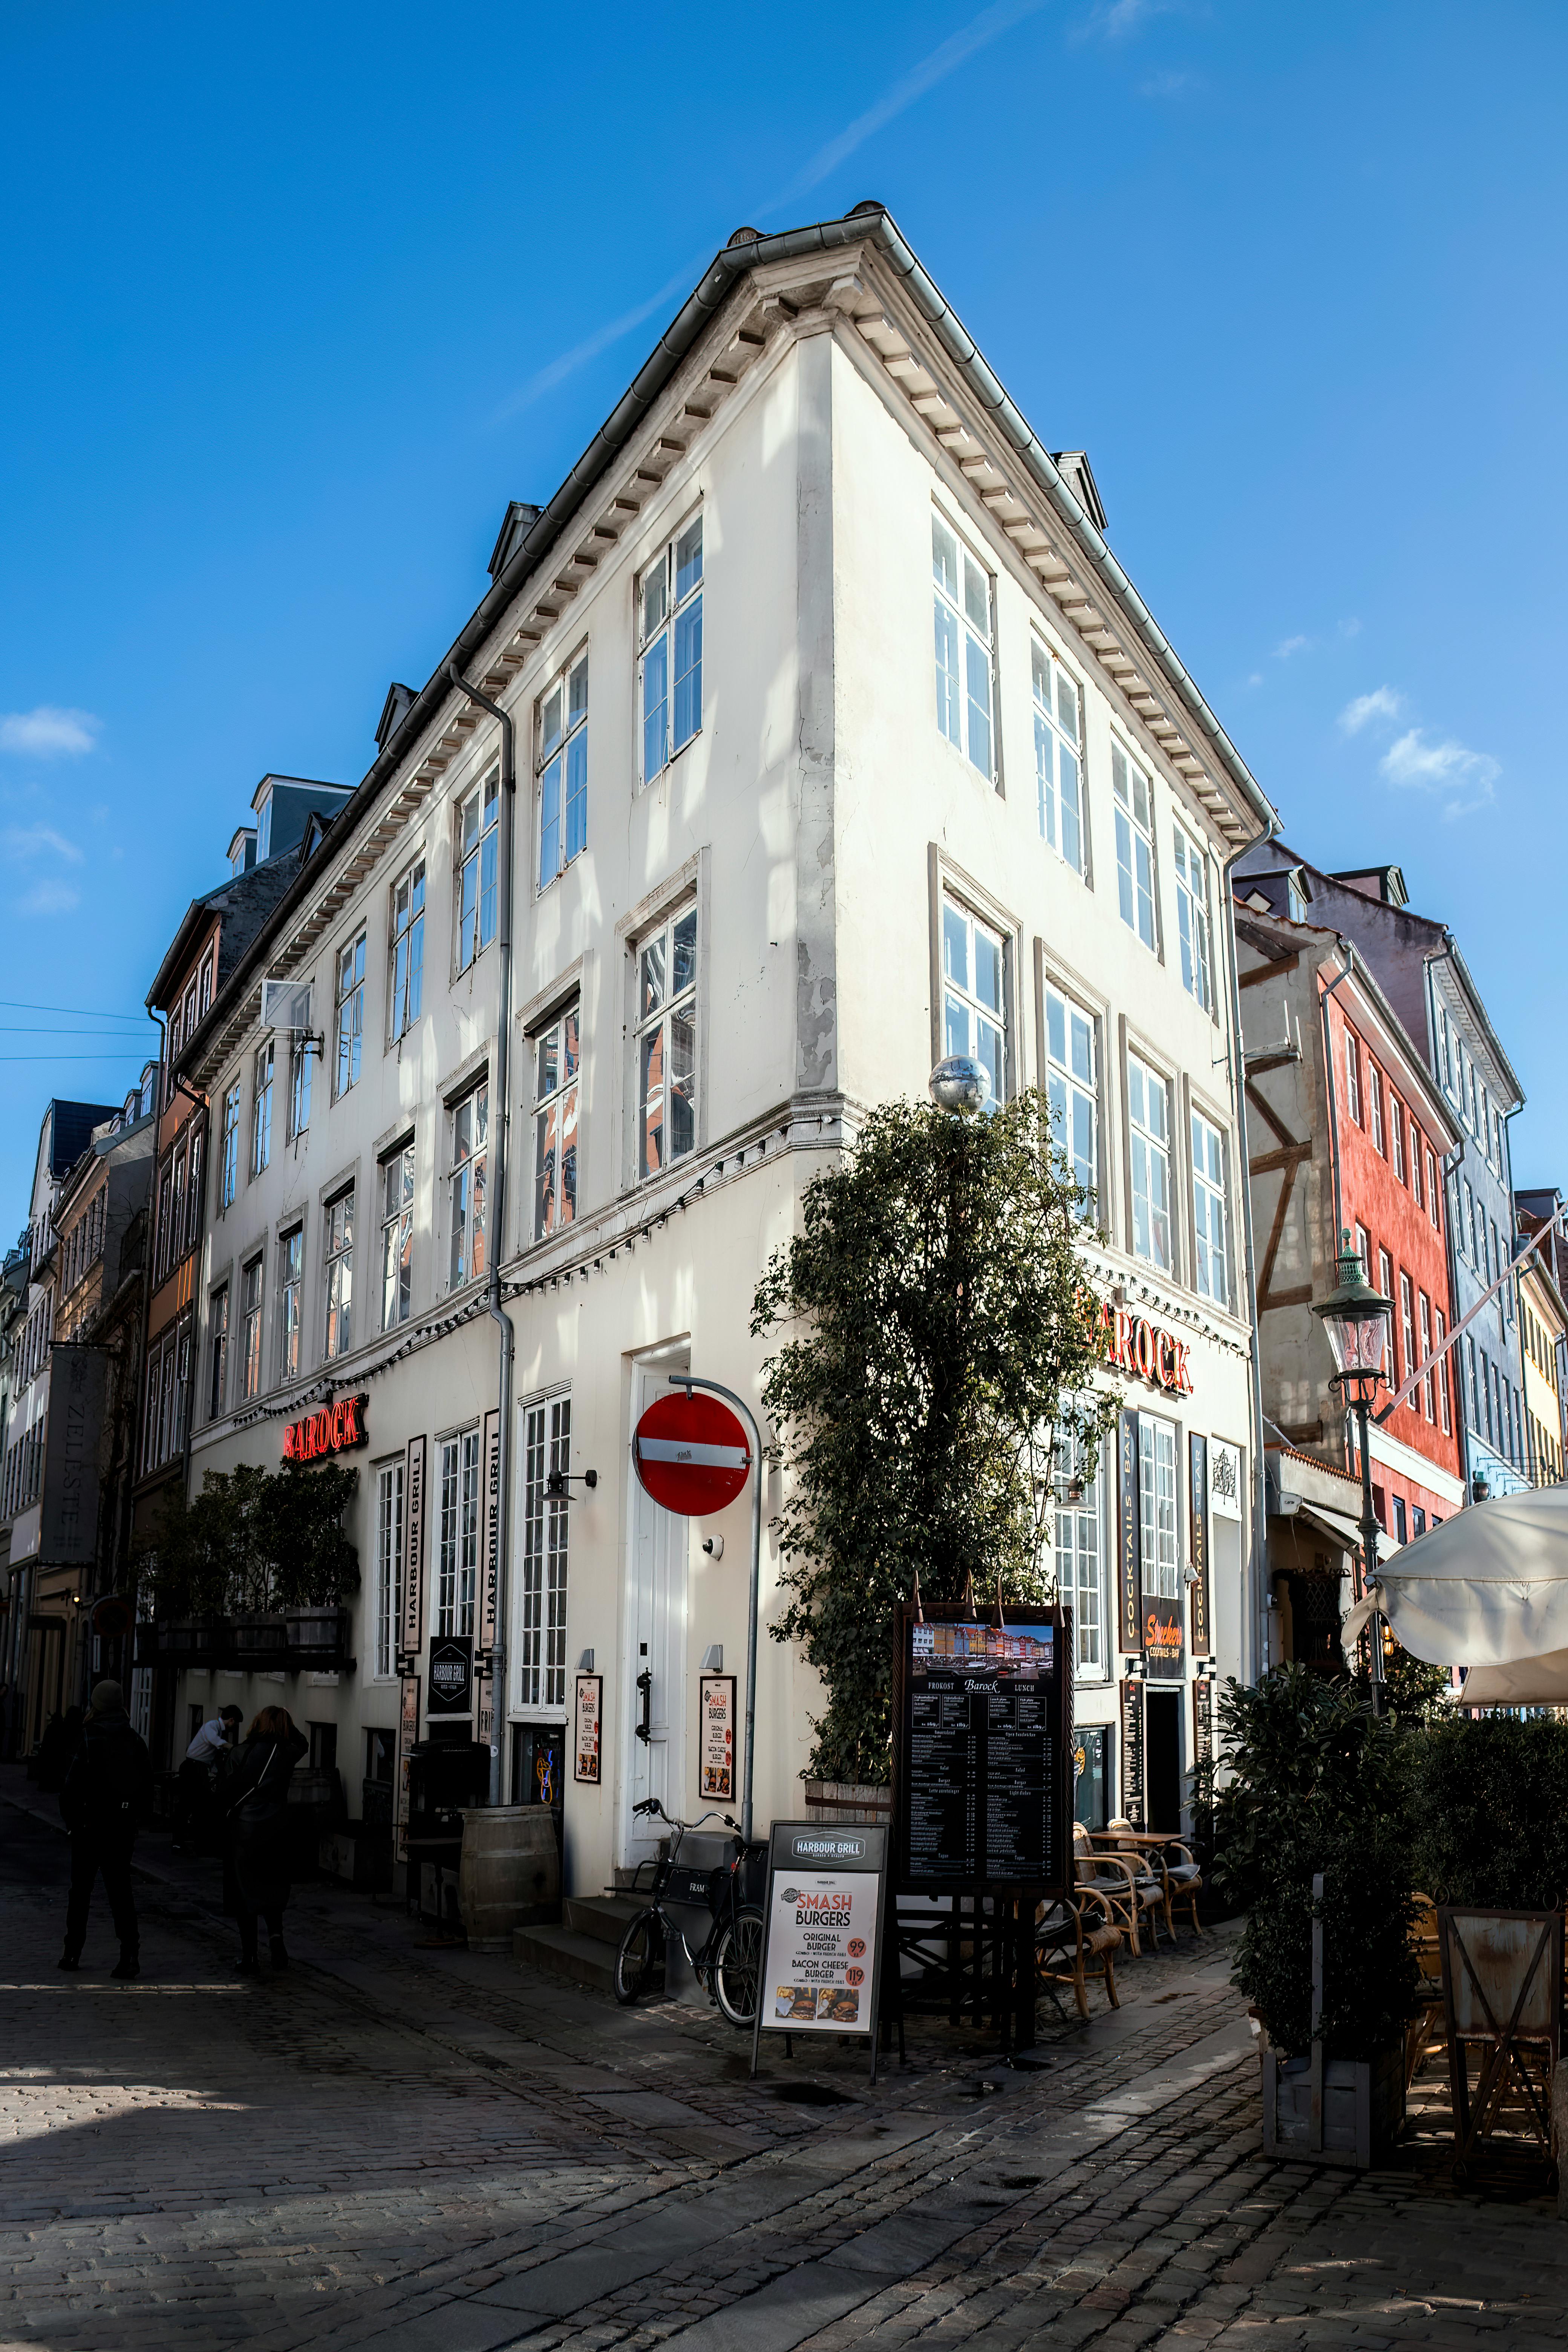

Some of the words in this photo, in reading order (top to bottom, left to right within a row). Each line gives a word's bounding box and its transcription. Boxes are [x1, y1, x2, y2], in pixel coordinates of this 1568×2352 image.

[283, 1397, 361, 1461] BAROCK
[61, 1405, 85, 1525] ZELESTE
[412, 1452, 420, 1514] GRILL
[1125, 1495, 1135, 1638] COCKTAILS
[409, 1521, 418, 1628] HARBOUR
[928, 1682, 954, 1690] FROKOST
[964, 1679, 1000, 1694] Barock
[1014, 1684, 1034, 1692] LUNCH
[797, 1841, 835, 1853] HARBOUR
[837, 1843, 860, 1854] GRILL
[797, 1893, 852, 1911] SMASH
[796, 1910, 850, 1926] BURGERS
[803, 1932, 841, 1942] ORIGINAL
[807, 1942, 836, 1951] BURGER
[850, 1941, 865, 1953] 99
[792, 1960, 819, 1969] BACON
[822, 1961, 849, 1970] CHEESE
[805, 1970, 834, 1978] BURGER
[849, 1969, 864, 1982] 119
